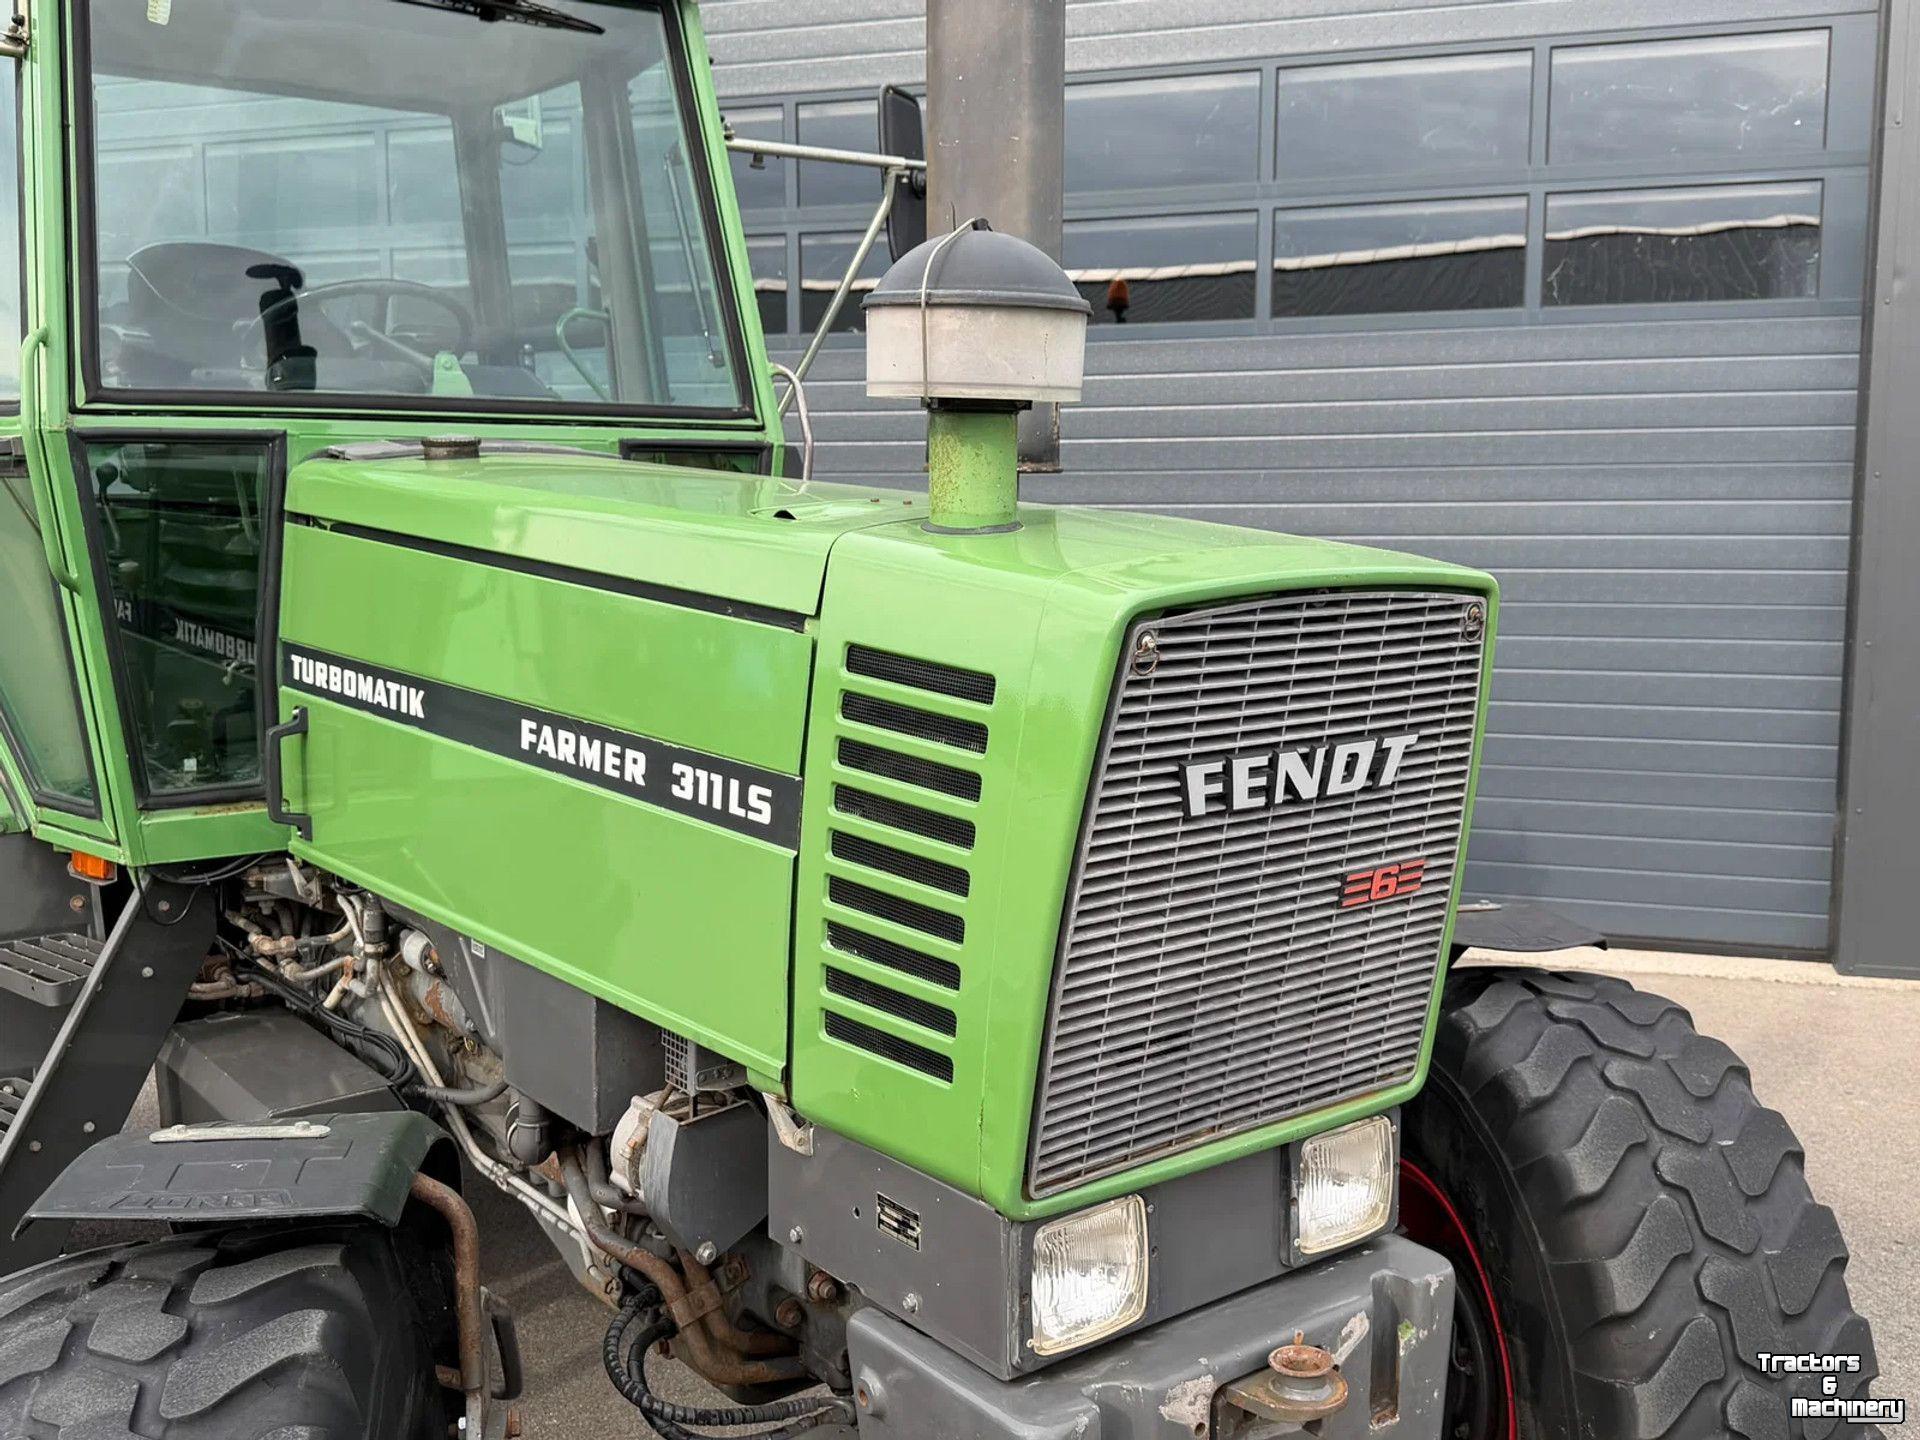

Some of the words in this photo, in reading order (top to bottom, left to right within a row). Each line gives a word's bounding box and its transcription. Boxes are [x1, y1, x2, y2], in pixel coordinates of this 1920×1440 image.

[291, 654, 425, 718] TURBOMATIK
[521, 718, 647, 786] FARMER
[1182, 733, 1419, 817] FENDT
